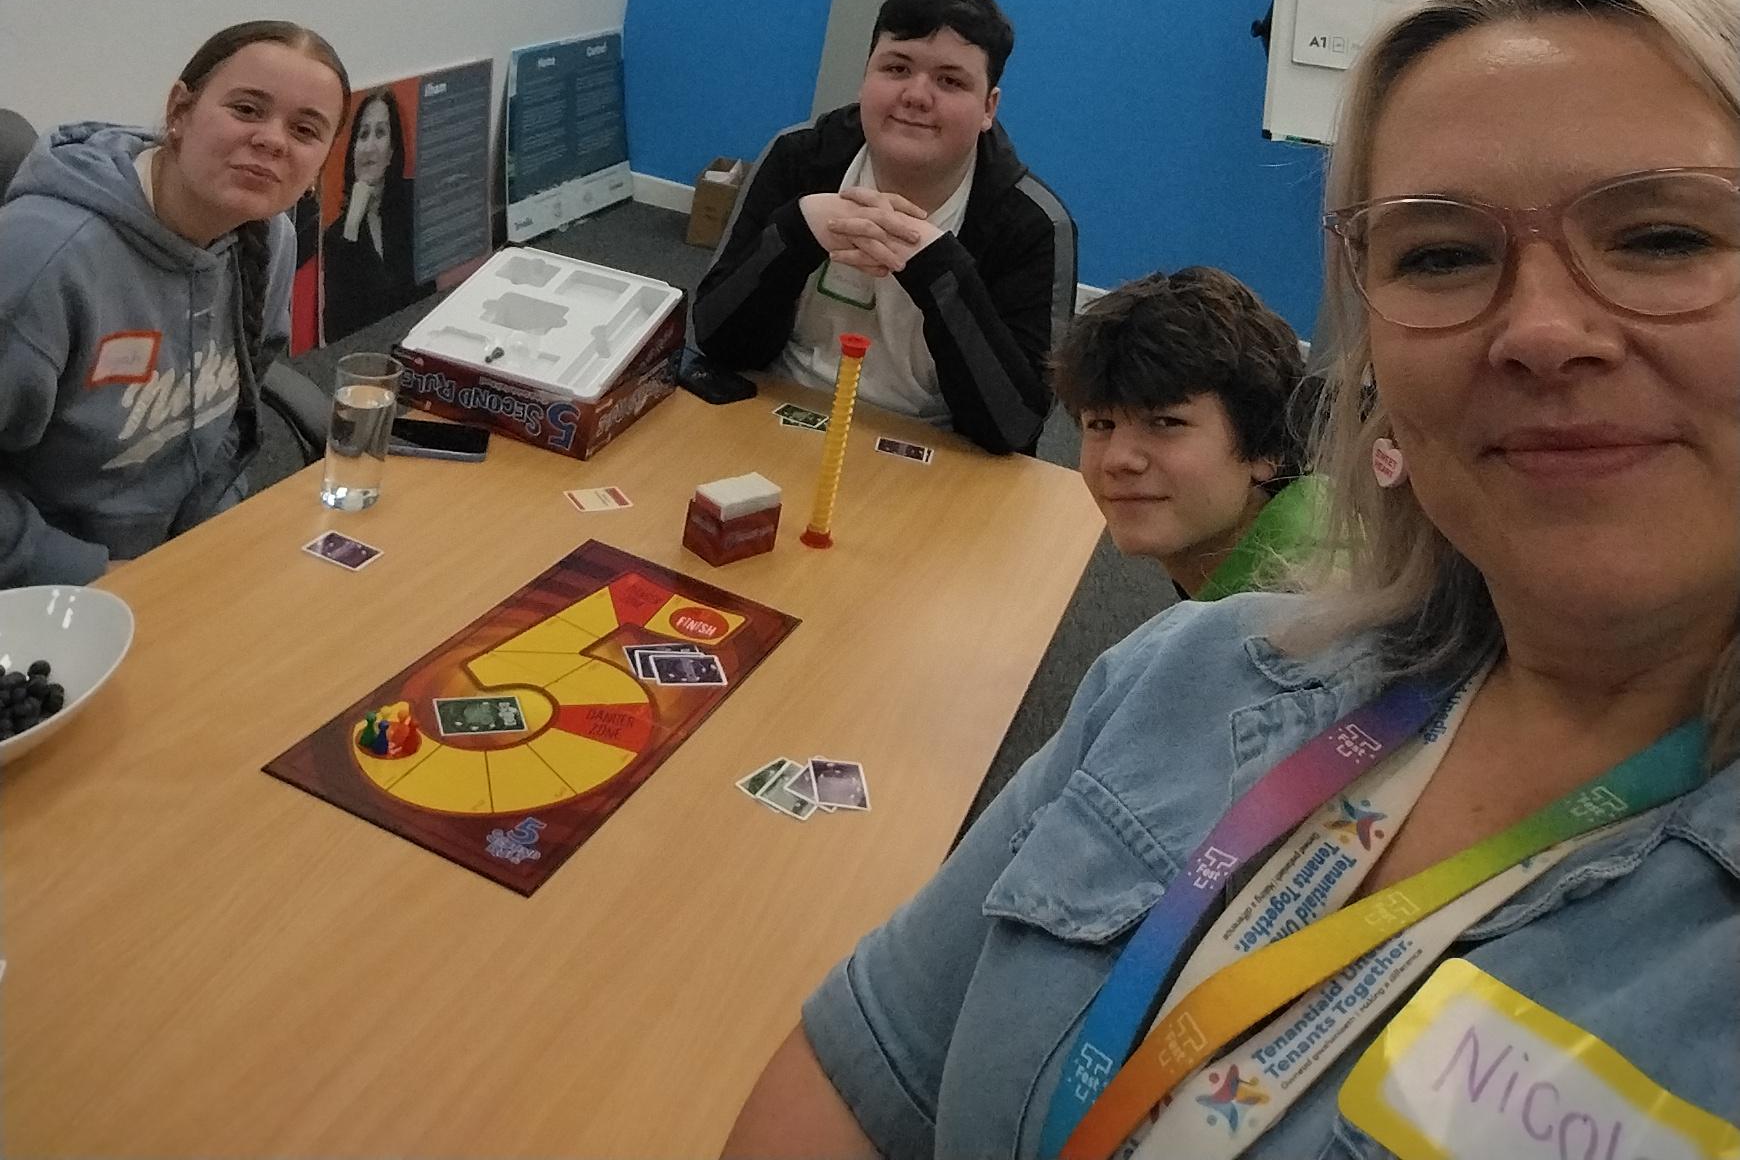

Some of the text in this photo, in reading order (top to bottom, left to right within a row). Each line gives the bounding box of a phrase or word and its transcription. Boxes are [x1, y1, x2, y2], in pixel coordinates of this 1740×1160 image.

[1309, 36, 1327, 48] A1
[546, 400, 581, 450] 5
[676, 617, 717, 636] FINISH
[506, 816, 548, 844] 5
[1291, 840, 1340, 890] Tenants
[1293, 853, 1357, 926] Tenantiaid
[1234, 885, 1301, 955] Together.
[1251, 979, 1345, 1067] Tenantiaid
[1263, 938, 1414, 1081] Tenants Together.
